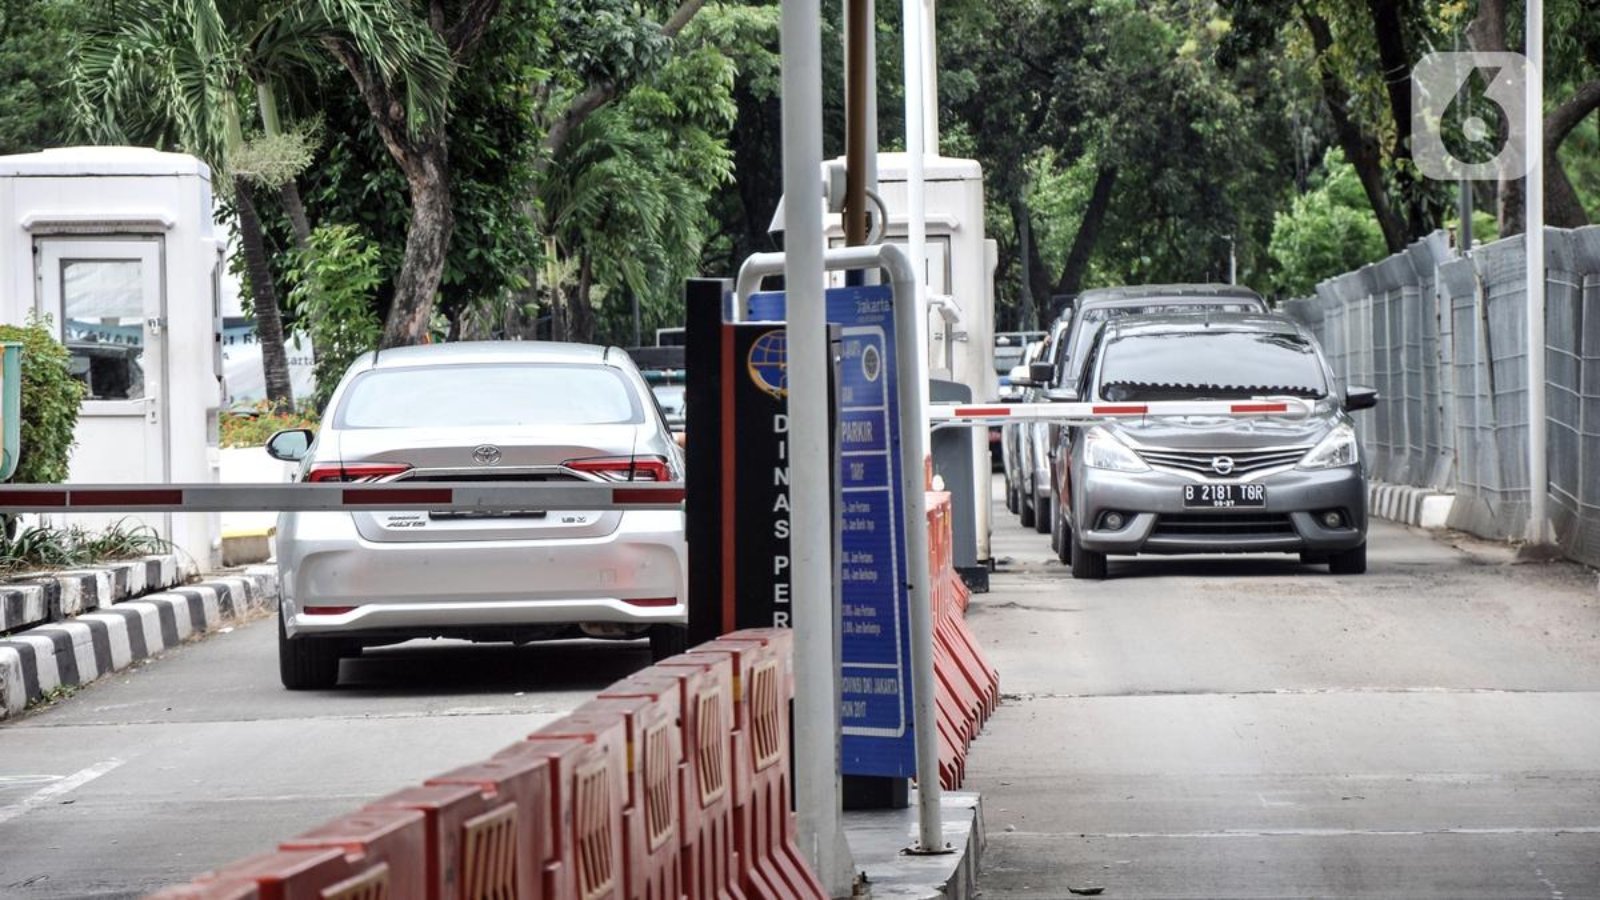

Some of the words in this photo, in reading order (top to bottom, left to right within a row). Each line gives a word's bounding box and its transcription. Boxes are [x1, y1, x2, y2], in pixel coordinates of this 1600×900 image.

[842, 421, 873, 442] PARKIR
[773, 414, 790, 538] DINAS
[1186, 485, 1194, 500] B
[1202, 485, 1231, 500] 2181
